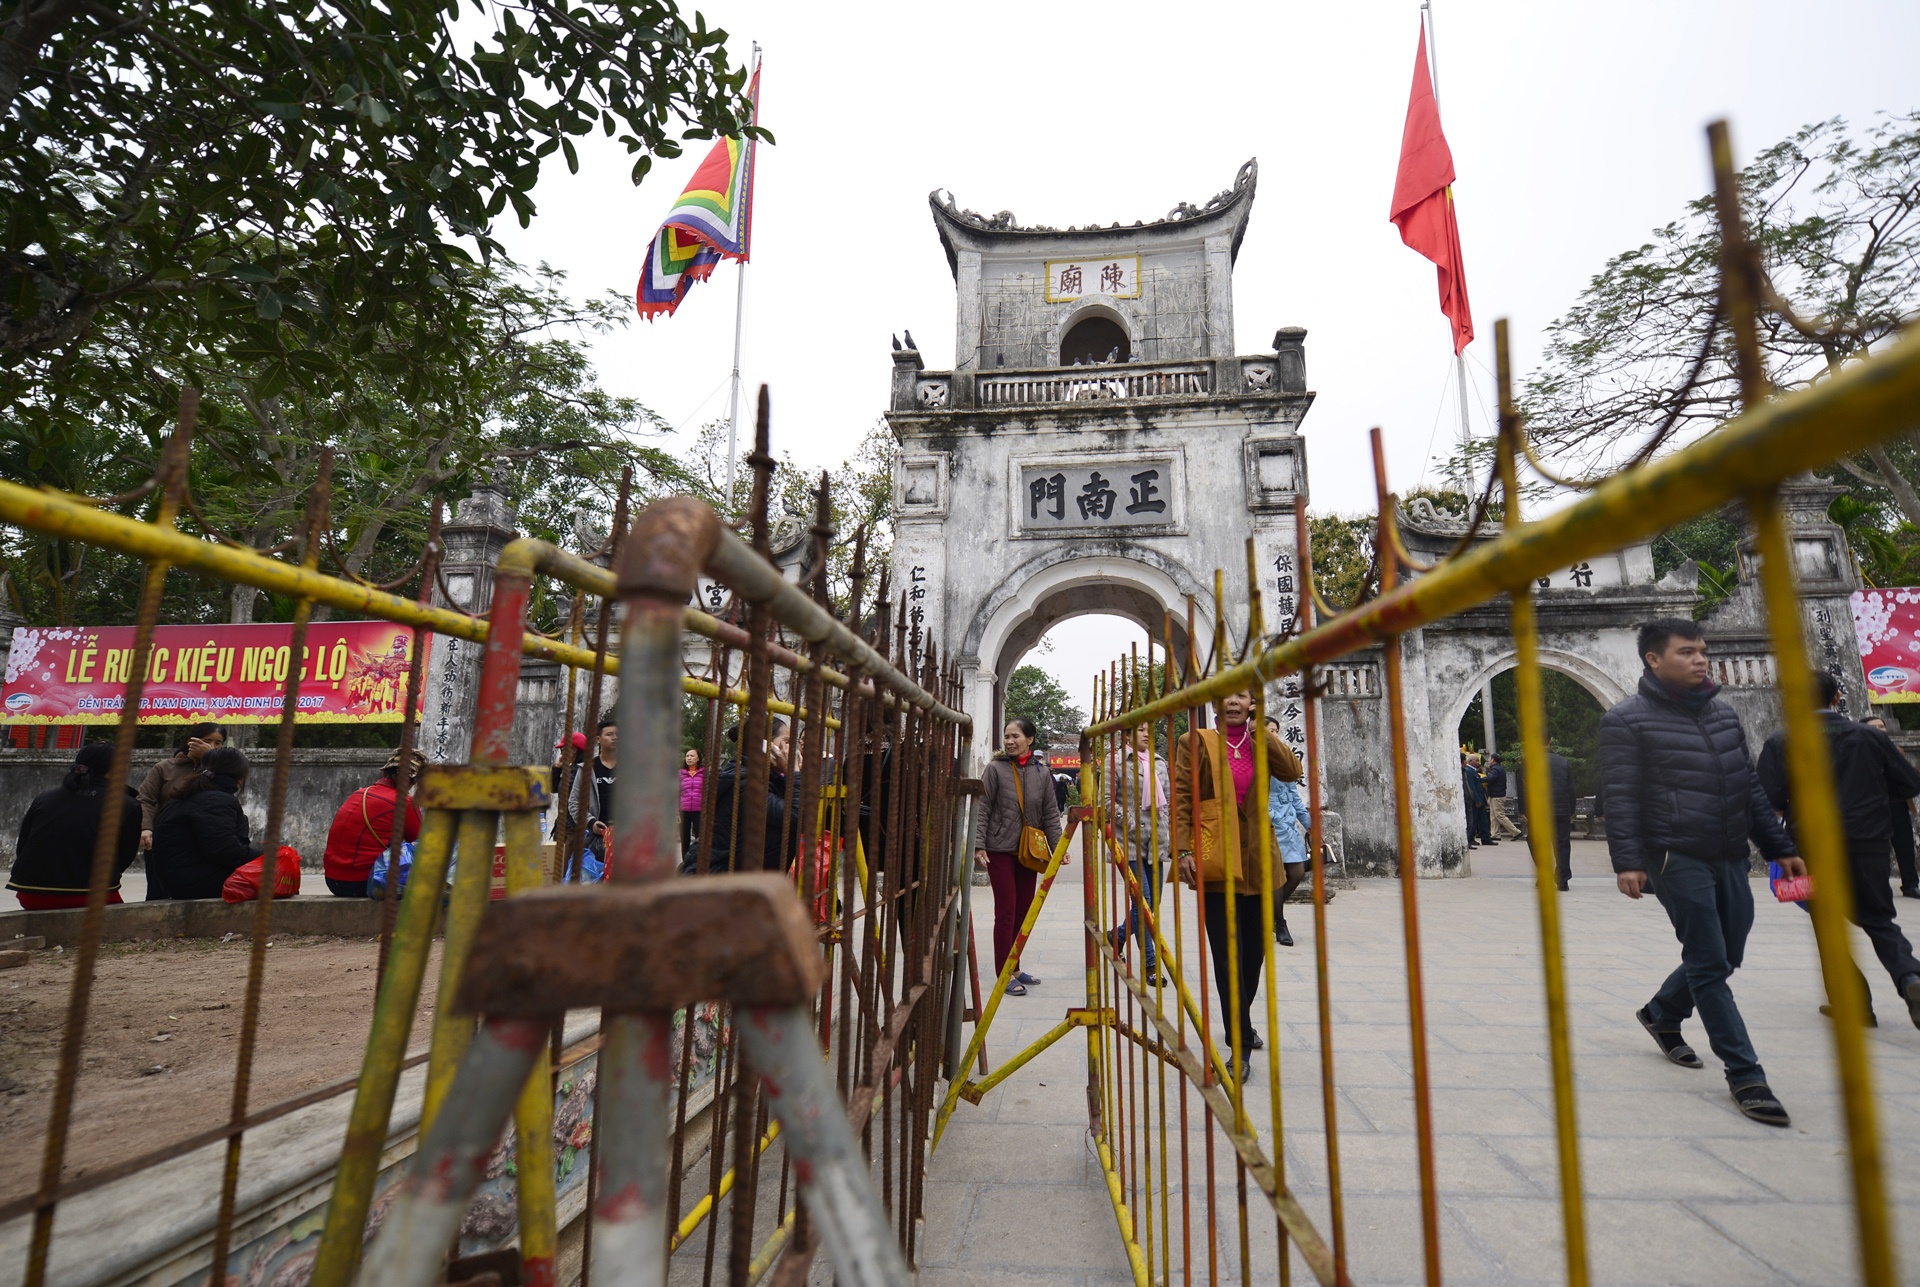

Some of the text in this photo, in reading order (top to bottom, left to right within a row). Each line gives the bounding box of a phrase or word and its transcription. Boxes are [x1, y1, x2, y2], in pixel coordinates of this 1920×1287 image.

[65, 635, 98, 683] LỄ
[174, 640, 235, 691] KIỆU
[315, 638, 348, 690] LỘ
[153, 698, 179, 708] NAM
[210, 695, 242, 709] XUÂN
[244, 697, 271, 708] ĐINH
[299, 697, 324, 707] 2017
